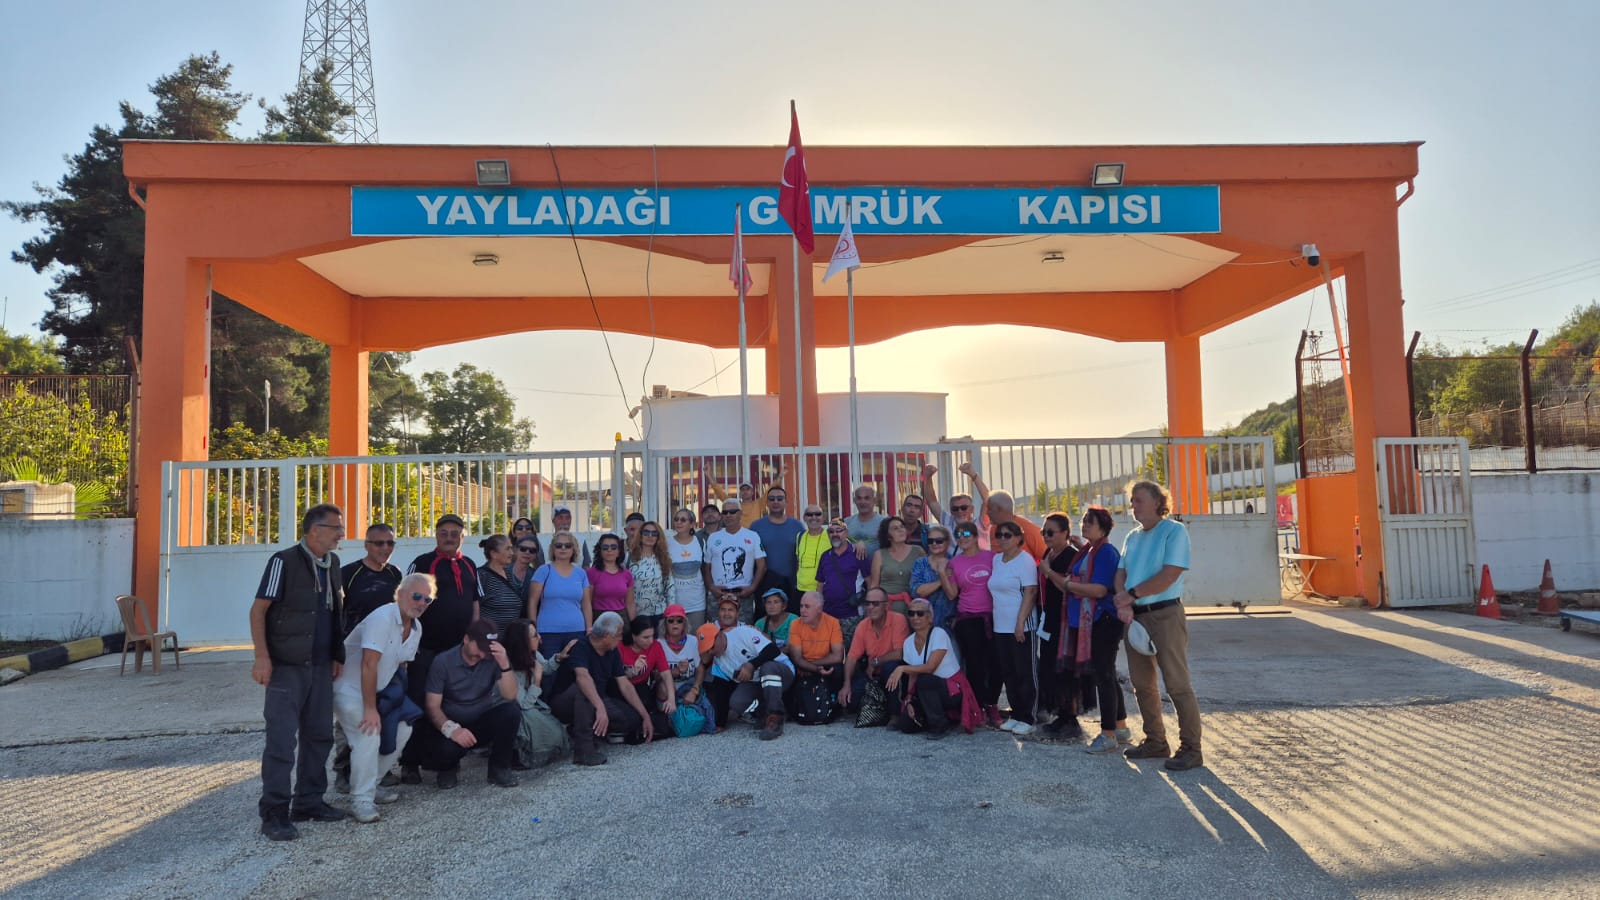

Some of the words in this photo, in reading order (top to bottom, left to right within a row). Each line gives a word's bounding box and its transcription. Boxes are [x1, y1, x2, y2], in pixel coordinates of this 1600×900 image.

[416, 188, 671, 226] YAYLADAĞI
[749, 189, 943, 226] GMRÜK
[1018, 195, 1162, 225] KAPISI
